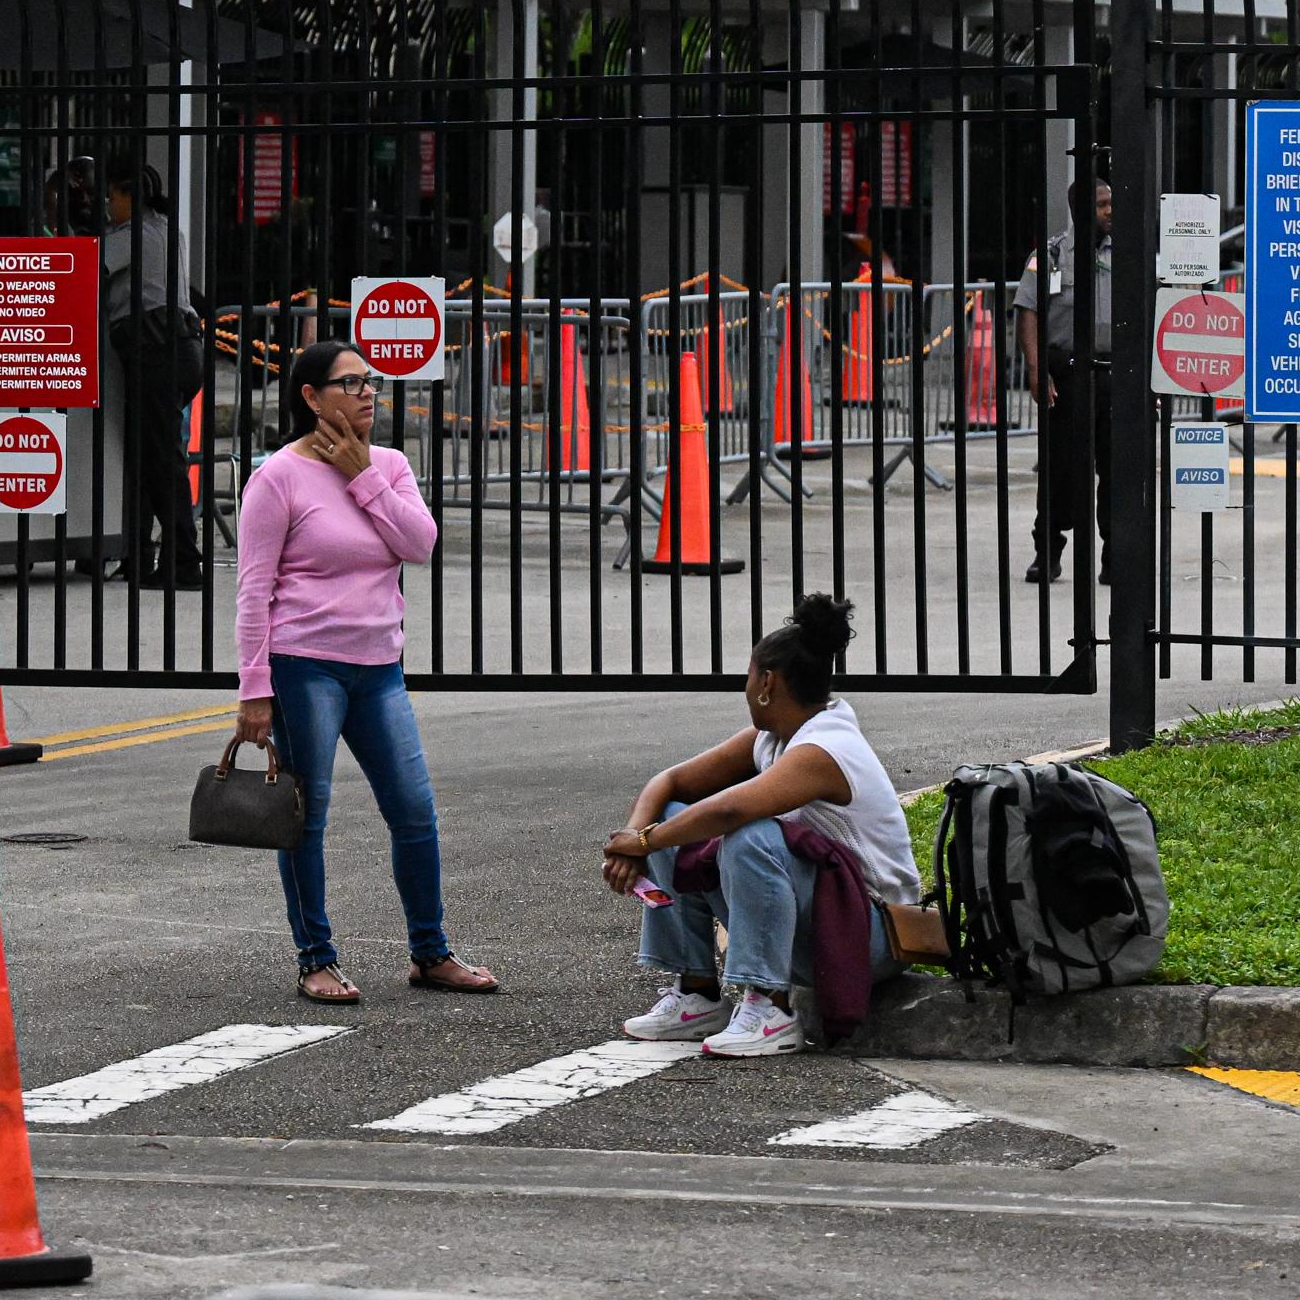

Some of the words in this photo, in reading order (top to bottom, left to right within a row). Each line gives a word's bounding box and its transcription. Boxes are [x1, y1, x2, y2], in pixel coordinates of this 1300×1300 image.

[1275, 197, 1290, 212] IN
[6, 281, 56, 291] WEAPONS
[6, 294, 55, 304] CAMERAS
[0, 307, 14, 317] NO
[15, 307, 46, 317] VIDEO
[368, 299, 390, 314] DO
[394, 299, 428, 314] NOT
[1172, 312, 1196, 329] DO
[1206, 315, 1240, 332] NOT
[0, 328, 46, 342] AVISO
[370, 343, 424, 359] ENTER
[46, 353, 81, 363] ARMAS
[39, 367, 87, 376] CAMARAS
[1176, 356, 1231, 376] ENTER
[46, 380, 82, 390] VIDEOS
[1177, 430, 1222, 441] NOTICE
[18, 434, 50, 449] NOT
[1180, 471, 1219, 482] AVISO
